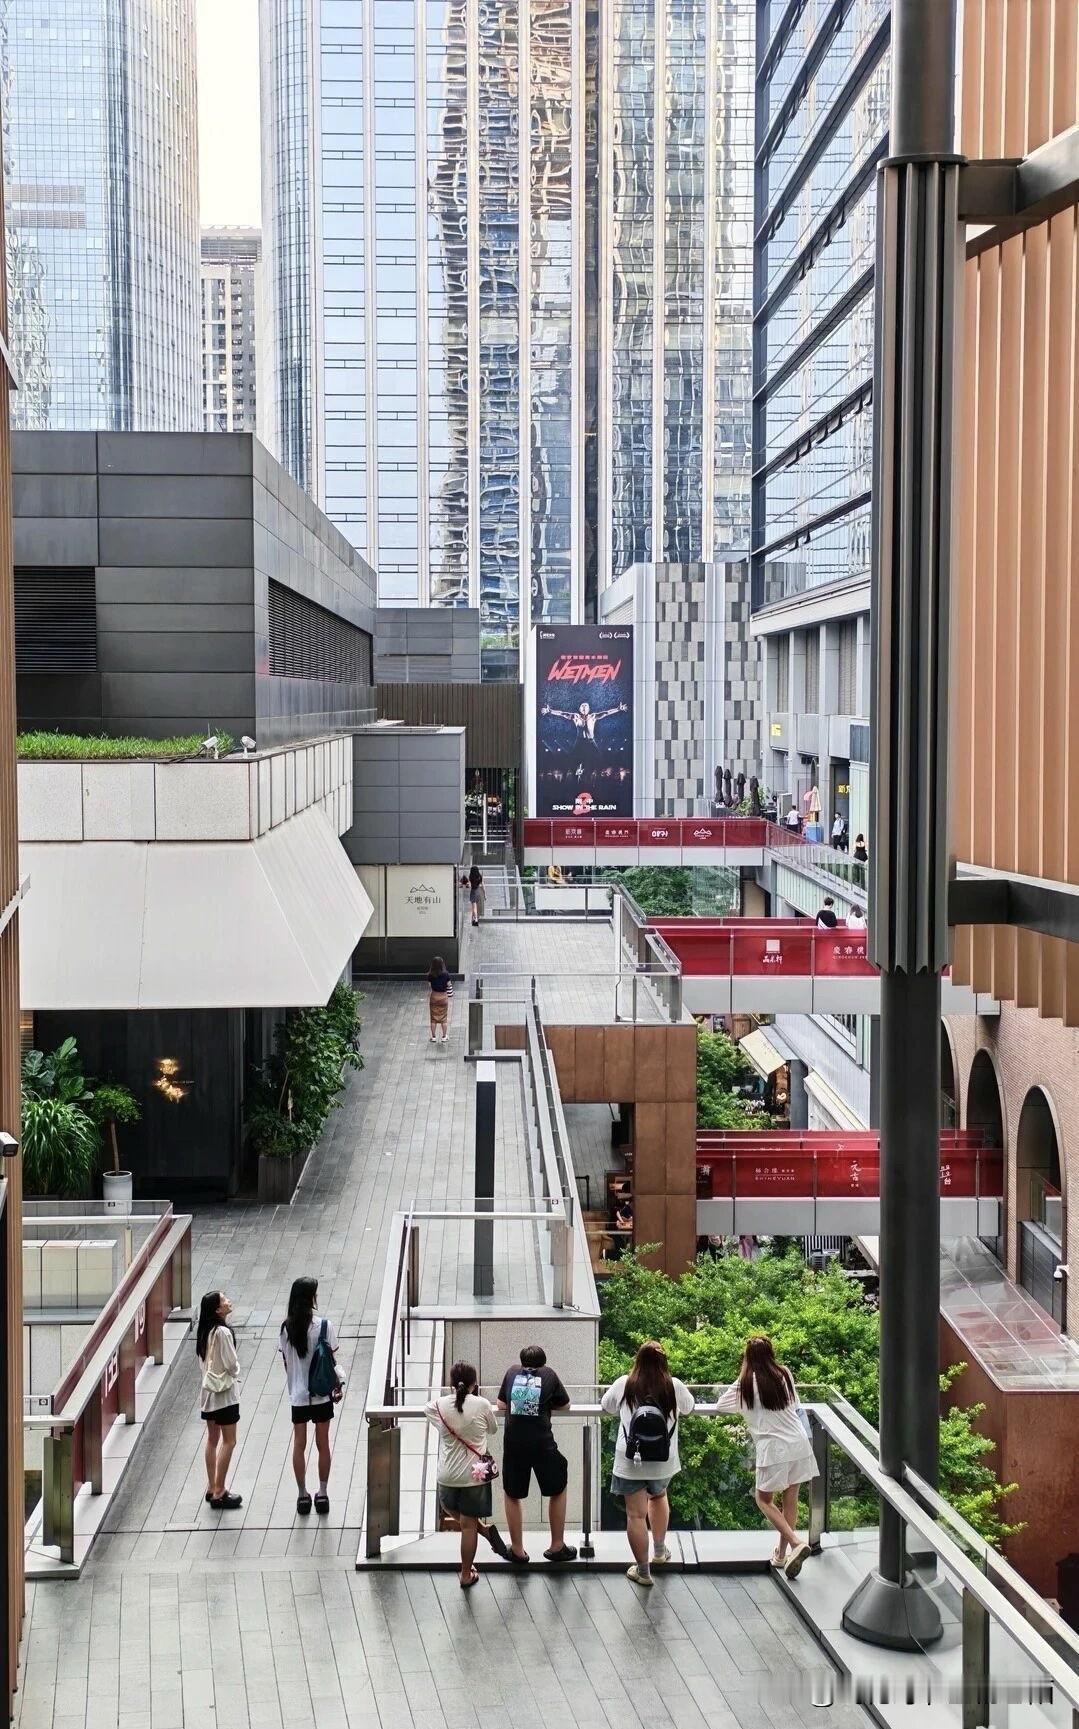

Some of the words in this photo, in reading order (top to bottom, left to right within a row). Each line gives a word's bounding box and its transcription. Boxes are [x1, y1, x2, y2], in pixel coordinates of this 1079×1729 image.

[548, 659, 621, 685] WETMEN
[406, 896, 441, 904] 天地有山
